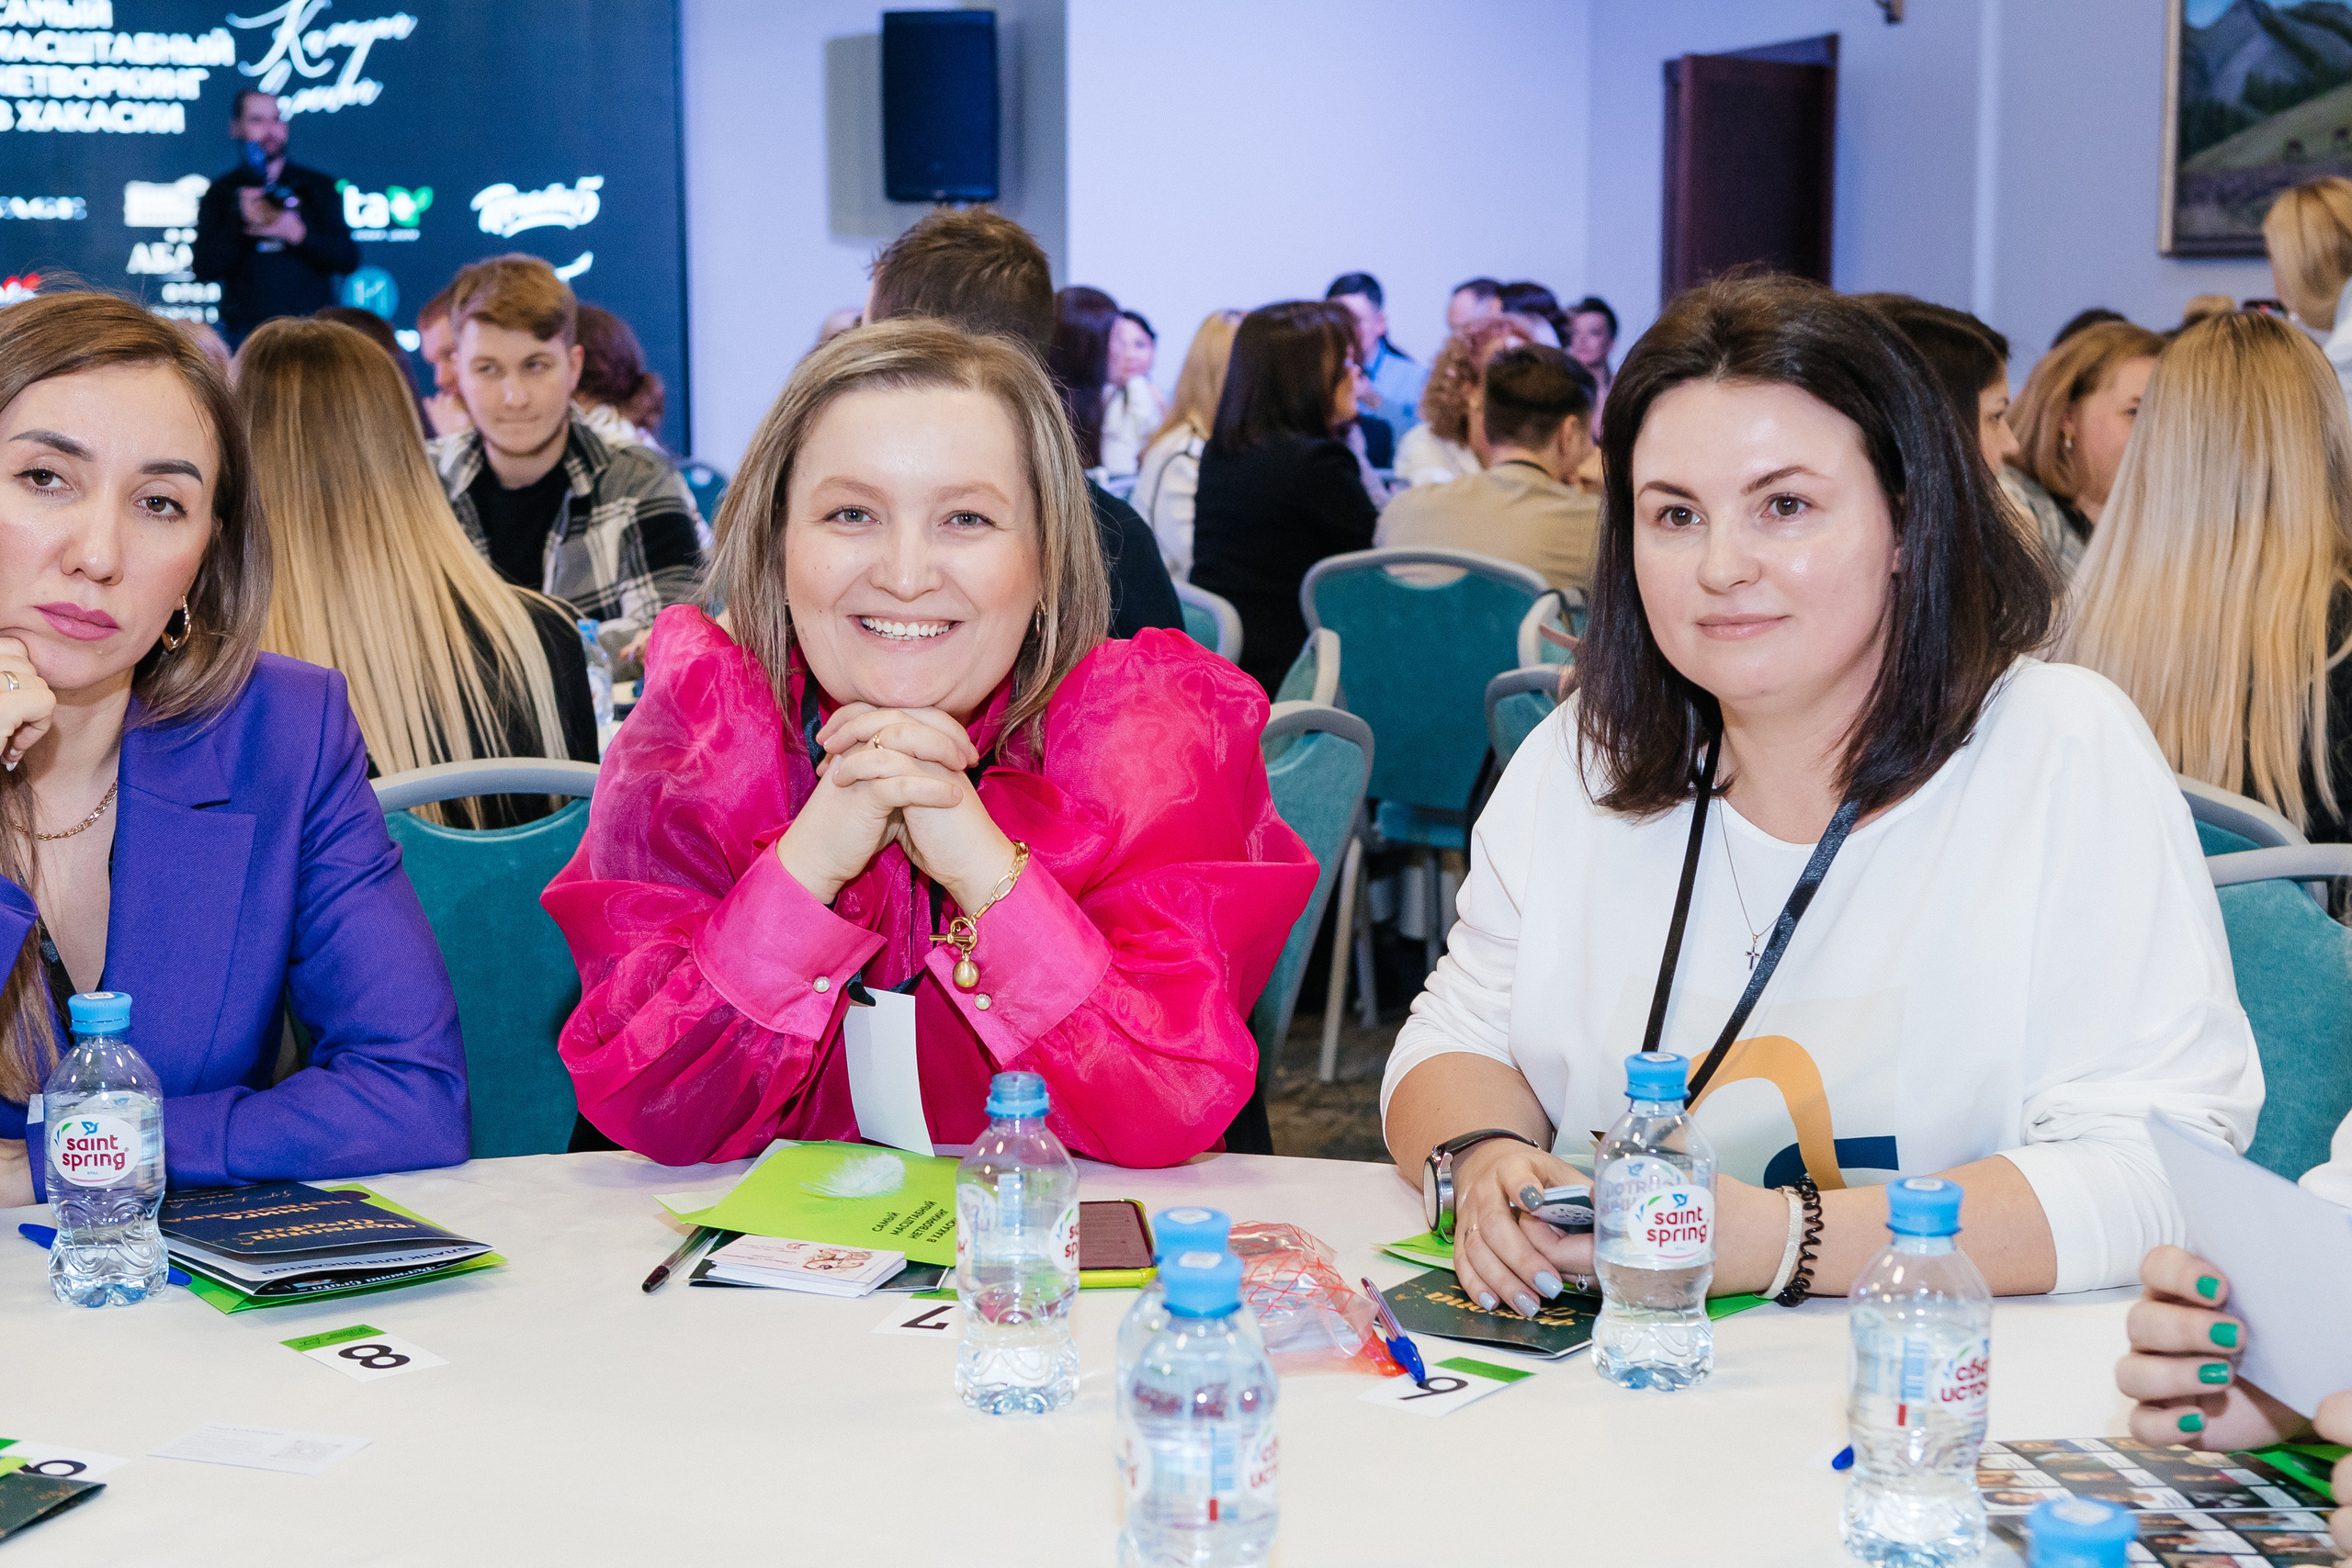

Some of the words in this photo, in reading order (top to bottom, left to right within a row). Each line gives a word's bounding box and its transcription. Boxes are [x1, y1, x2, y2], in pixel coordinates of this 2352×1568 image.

[15, 98, 186, 134] ХАКАСИИ
[66, 1134, 119, 1151] saint
[62, 1152, 125, 1171] spring
[872, 1211, 900, 1233] САМЫЙ
[889, 1200, 937, 1236] МАСШТАБНЫЙ
[908, 1208, 949, 1240] НЕТВОРКИНГ
[1655, 1206, 1703, 1225] saint
[1646, 1224, 1707, 1247] spring
[367, 1257, 406, 1266] ДЛЯ
[408, 1247, 470, 1261] БЛАНК
[338, 1344, 411, 1369] 8
